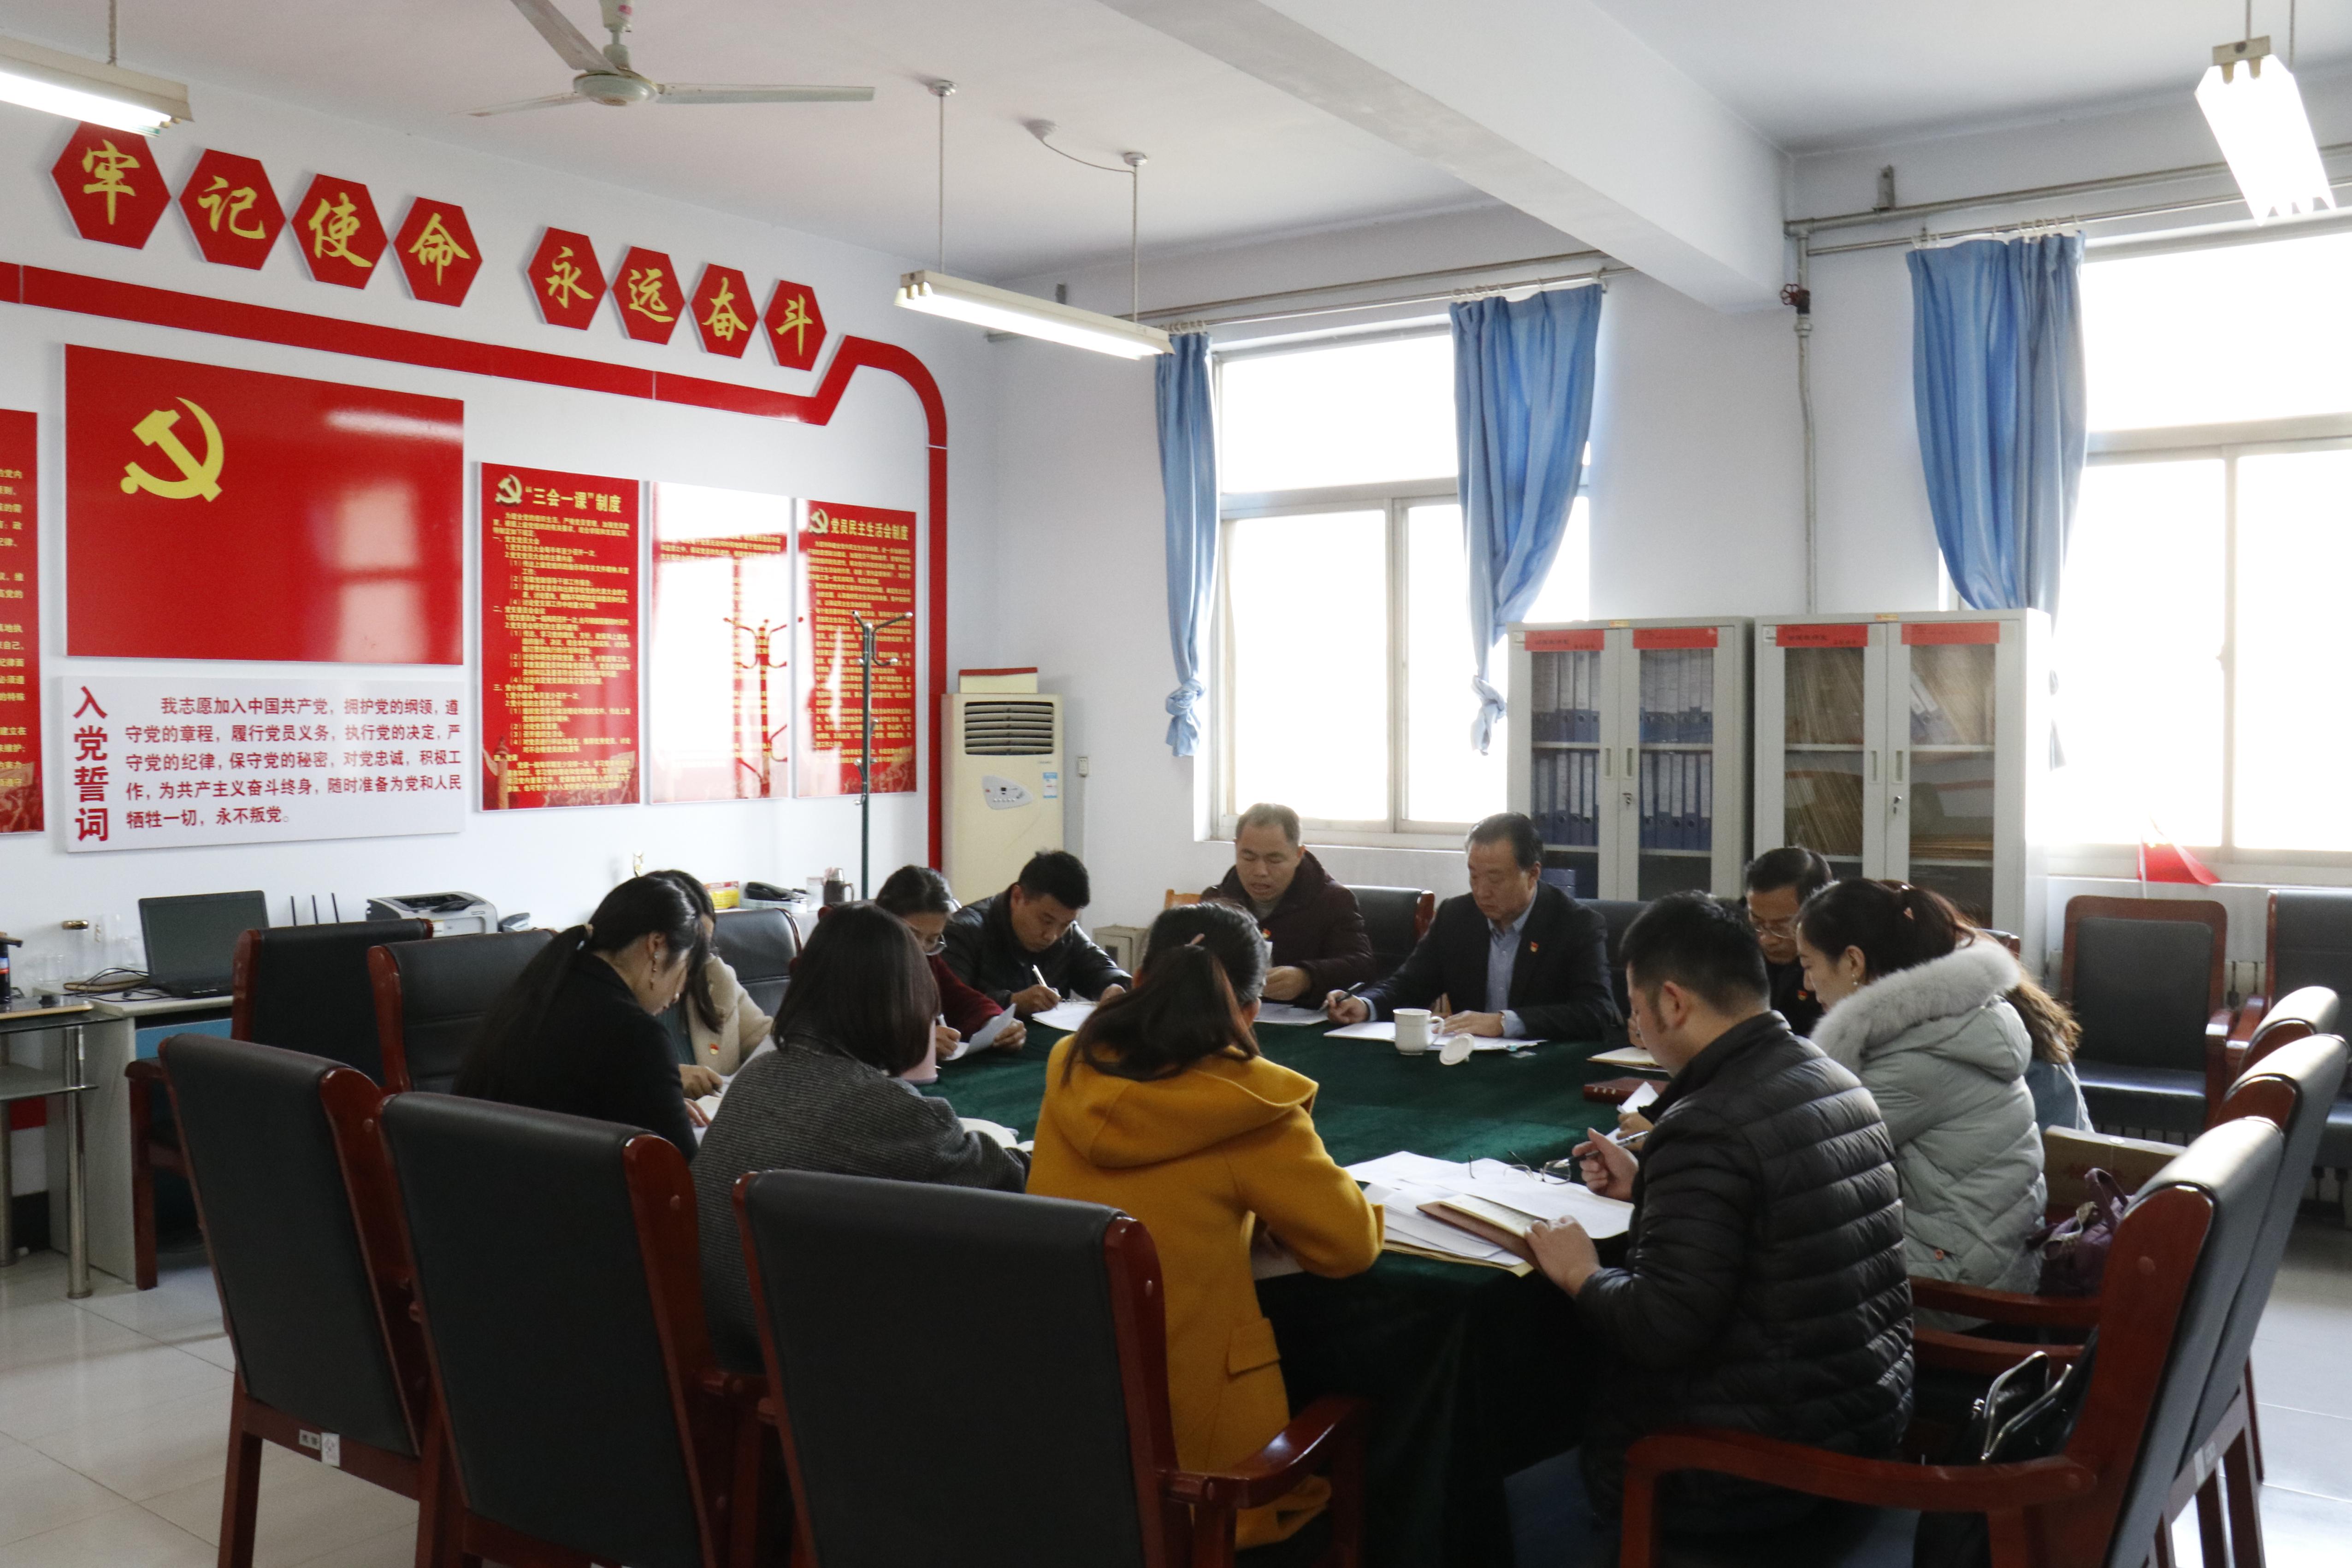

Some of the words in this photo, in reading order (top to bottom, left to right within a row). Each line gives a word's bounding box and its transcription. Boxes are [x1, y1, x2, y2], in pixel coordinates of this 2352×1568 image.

[82, 139, 470, 286] 牢记使命
[545, 246, 813, 356] 永远奋斗
[73, 686, 109, 842] 入党誓词
